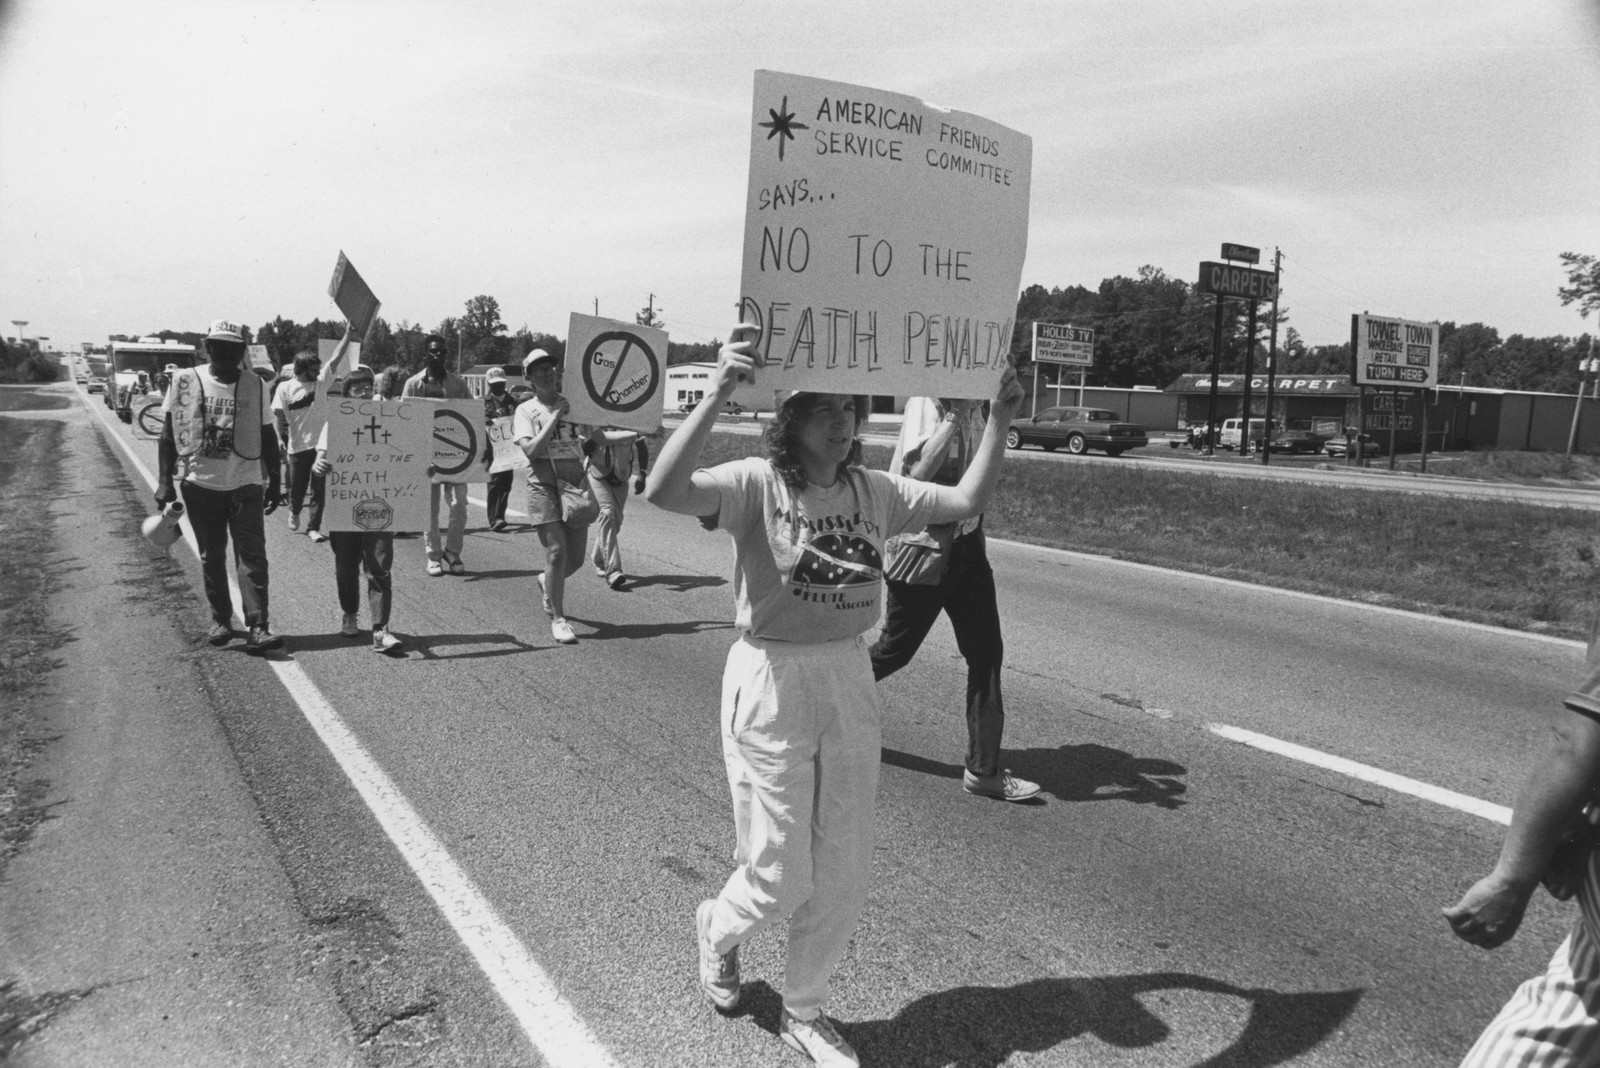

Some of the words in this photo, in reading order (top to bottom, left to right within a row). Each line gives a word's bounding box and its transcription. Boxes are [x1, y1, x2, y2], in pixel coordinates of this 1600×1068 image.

[816, 97, 922, 136] AMERICAN
[939, 122, 1000, 157] FRIENDS
[814, 129, 903, 162] SERVICE
[926, 148, 1013, 187] COMMITTEE
[758, 178, 835, 210] SAYS...
[760, 225, 810, 273] NO
[848, 234, 893, 278] TO
[918, 244, 972, 281] THE
[1211, 266, 1277, 298] CARPETS
[740, 296, 883, 372] DEATH
[1042, 326, 1075, 340] HOLLIS
[1079, 330, 1090, 342] TV
[1366, 319, 1401, 342] TOWEL
[1405, 324, 1433, 346] TOWN
[593, 351, 617, 370] Gas
[1368, 366, 1396, 379] TURN
[1400, 367, 1424, 381] HERE
[608, 373, 650, 405] Chamber
[339, 400, 413, 421] SCLC
[336, 453, 355, 464] NO
[365, 453, 380, 463] TO
[389, 453, 414, 464] THE
[330, 470, 387, 486] DEATH
[331, 482, 419, 500] PENALTY!!
[803, 591, 847, 604] FLUTE
